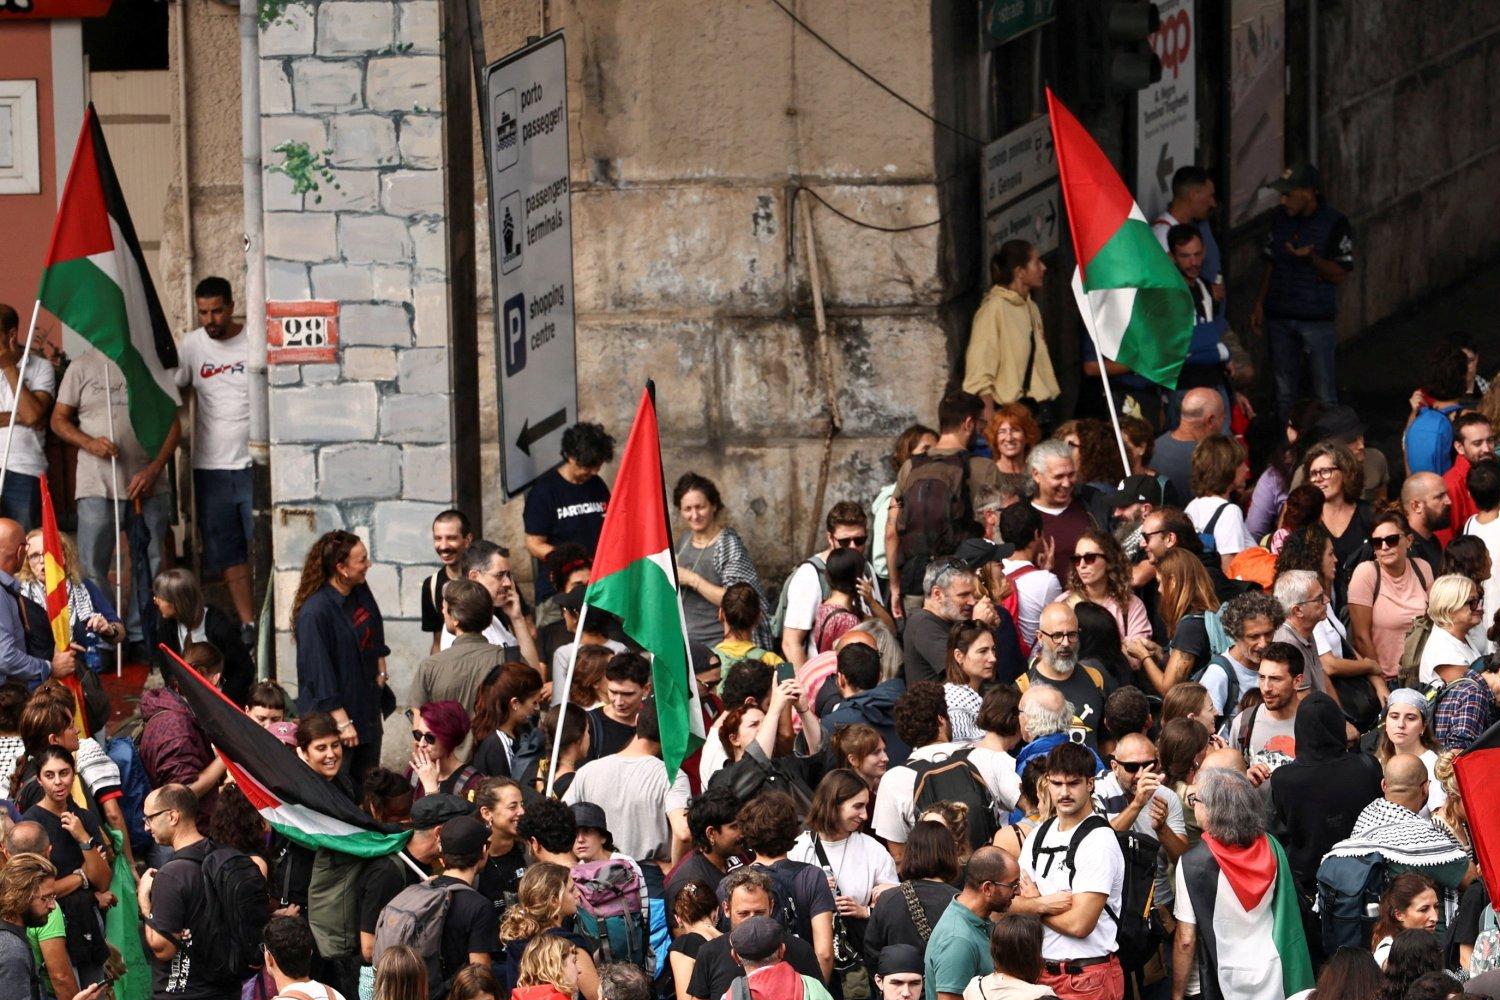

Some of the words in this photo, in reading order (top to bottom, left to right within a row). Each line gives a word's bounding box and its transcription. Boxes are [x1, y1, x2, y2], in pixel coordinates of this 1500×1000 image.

[520, 82, 543, 112] porto
[522, 101, 563, 145] passeggeri
[526, 176, 568, 215] passengers
[527, 209, 563, 246] terminals
[530, 283, 565, 319] shopping
[285, 318, 323, 346] 28
[531, 322, 556, 351] centre
